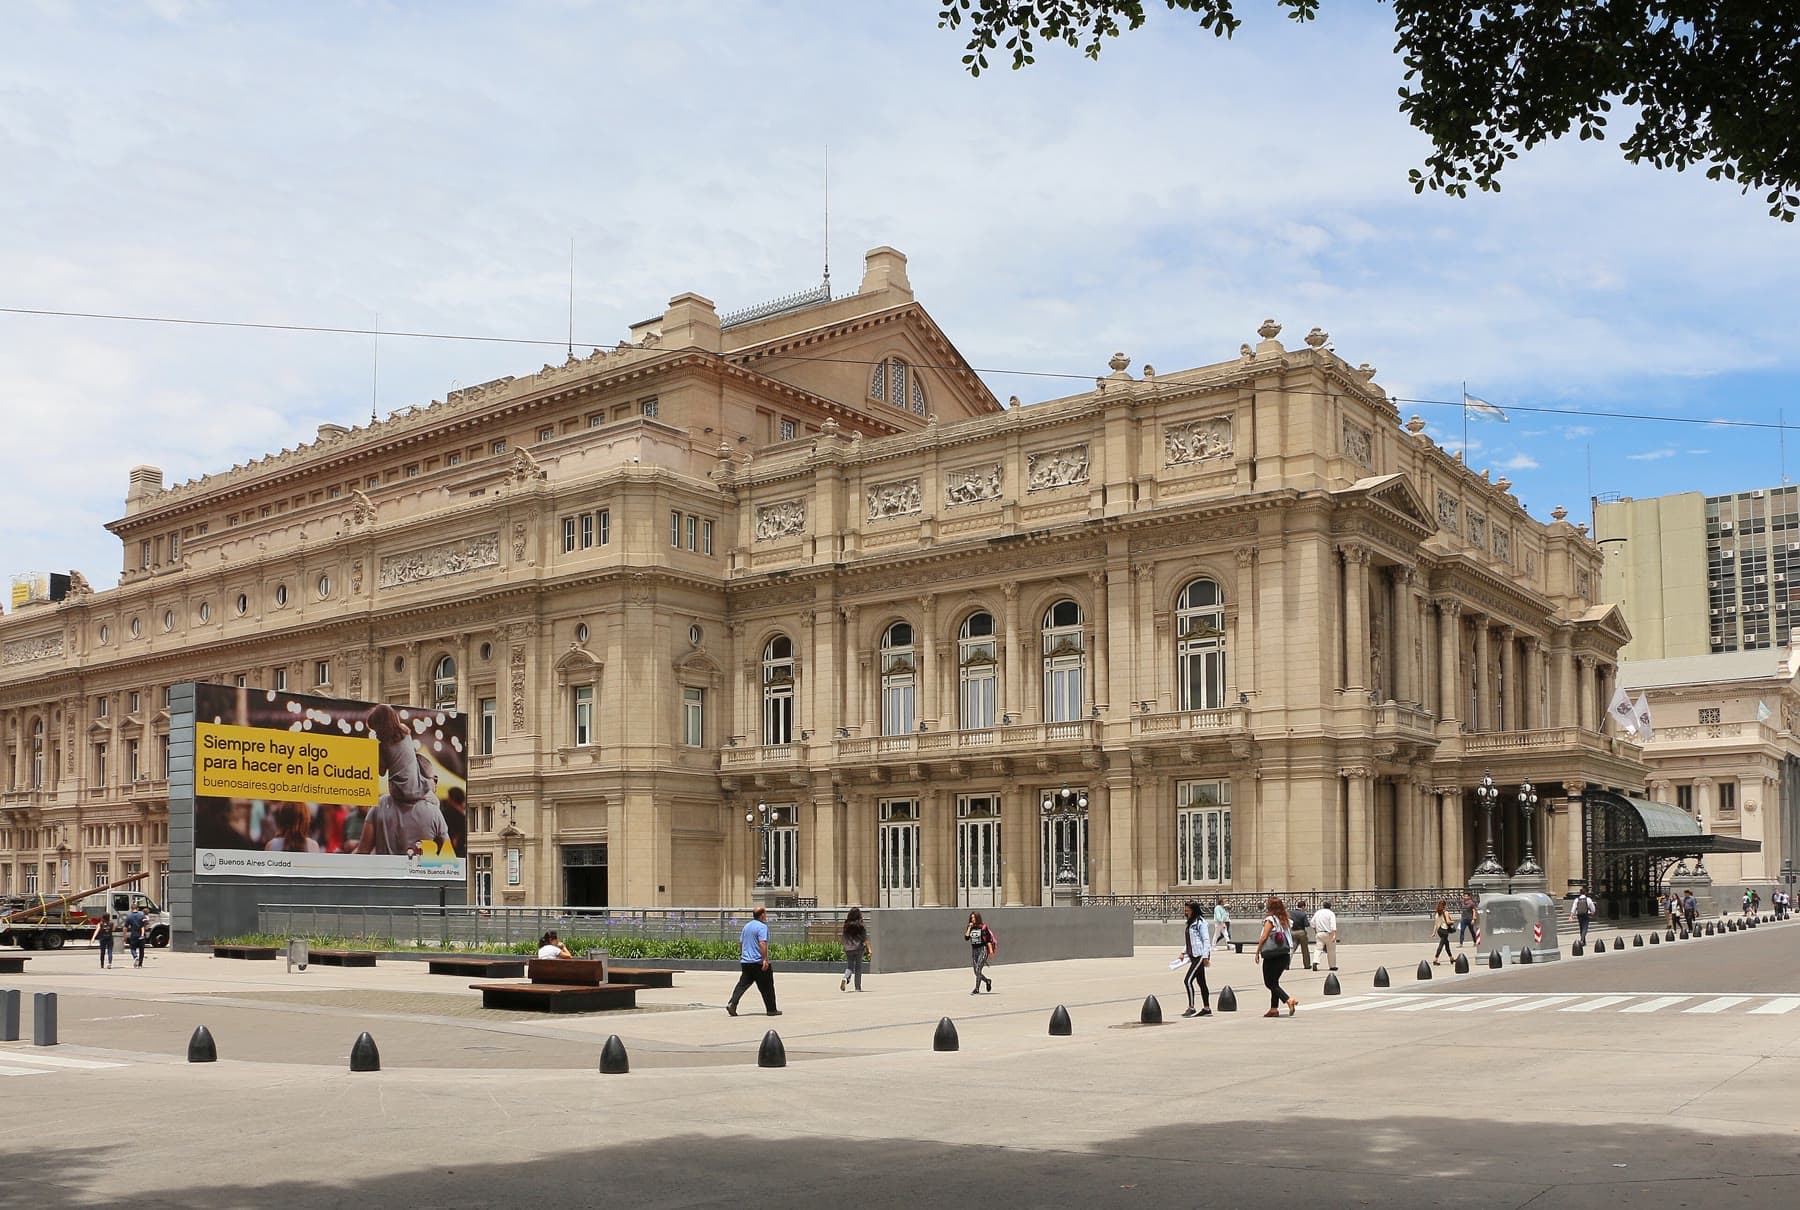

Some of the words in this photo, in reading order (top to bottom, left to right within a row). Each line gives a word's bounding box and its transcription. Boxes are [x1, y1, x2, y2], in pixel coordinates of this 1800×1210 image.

[203, 734, 265, 755] Siempre
[269, 739, 295, 759] hay
[298, 743, 328, 761] algo
[203, 757, 237, 772] para
[242, 756, 283, 773] hacer
[286, 763, 303, 775] en
[307, 761, 319, 776] la
[323, 764, 373, 780] Ciudad.
[203, 776, 371, 797] buenosaires.gob.ar/disfrutemosBA
[218, 858, 244, 866] Buenos
[246, 859, 265, 867] Aires
[266, 859, 291, 868] Ciudad
